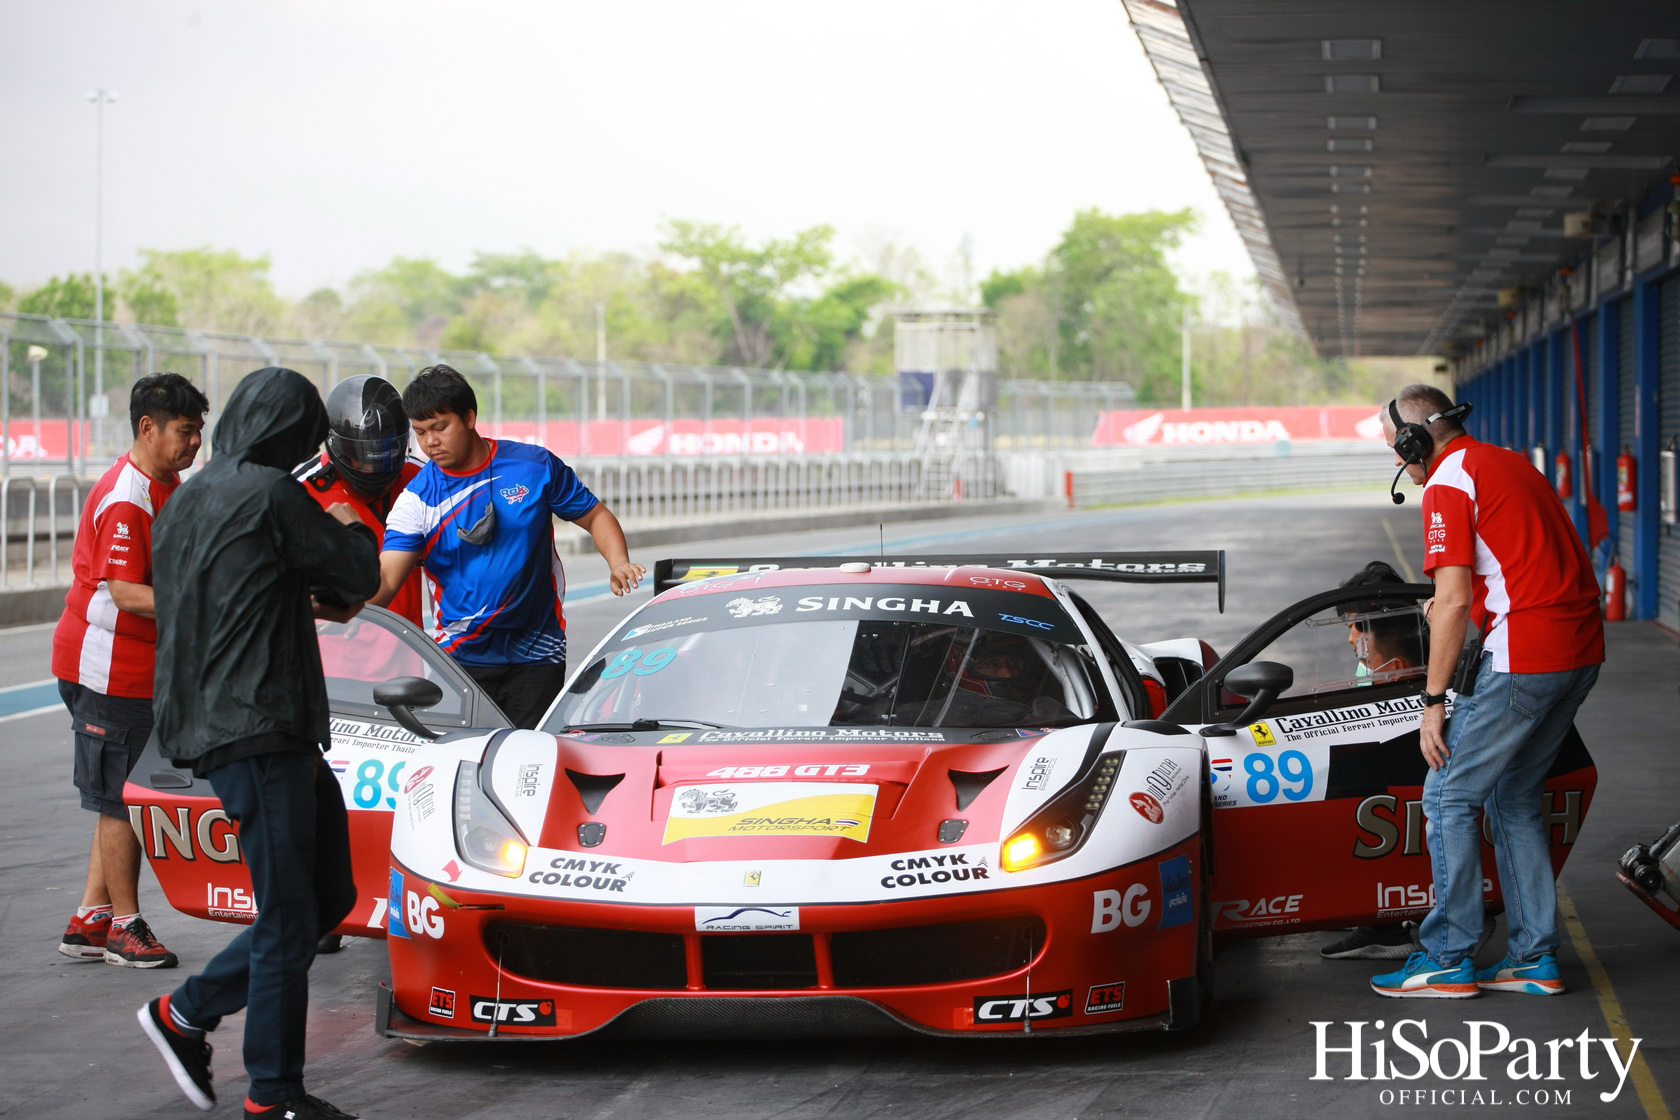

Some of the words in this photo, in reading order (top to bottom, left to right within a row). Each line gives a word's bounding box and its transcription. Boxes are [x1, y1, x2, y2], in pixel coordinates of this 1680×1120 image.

[669, 431, 804, 455] HONDA
[1160, 420, 1291, 444] HONDA
[795, 596, 975, 618] SINGHA
[998, 613, 1055, 631] TSCC
[600, 647, 678, 680] 89
[1275, 706, 1372, 735] Cavallino
[1284, 732, 1302, 743] The
[1304, 726, 1340, 739] Official
[1341, 720, 1376, 734] Ferrari
[1377, 714, 1419, 727] Importer
[700, 728, 827, 739] Cavallino
[834, 728, 944, 738] Motors
[522, 763, 544, 797] Inspire
[706, 765, 791, 779] 488
[794, 764, 871, 777] GT3
[1021, 757, 1049, 791] Inspire
[1243, 749, 1314, 804] 89
[735, 817, 831, 826] SINGHA
[1352, 789, 1585, 860] SIH
[550, 857, 622, 875] CMYK
[890, 854, 969, 872] CMYK
[528, 871, 627, 893] COLOUR
[880, 867, 990, 889] COLOUR
[407, 889, 445, 940] BG
[1090, 882, 1152, 934] BG
[1211, 894, 1304, 929] RACE
[1223, 920, 1271, 930] CONNECTION
[431, 990, 454, 1009] ETS
[1089, 985, 1123, 1005] ETS
[430, 1006, 441, 1014] RACING
[441, 1008, 453, 1016] FUELS
[473, 1001, 539, 1022] CTS
[978, 996, 1058, 1020] CTS
[1087, 1004, 1107, 1012] RACING
[1107, 1002, 1122, 1010] FUELS
